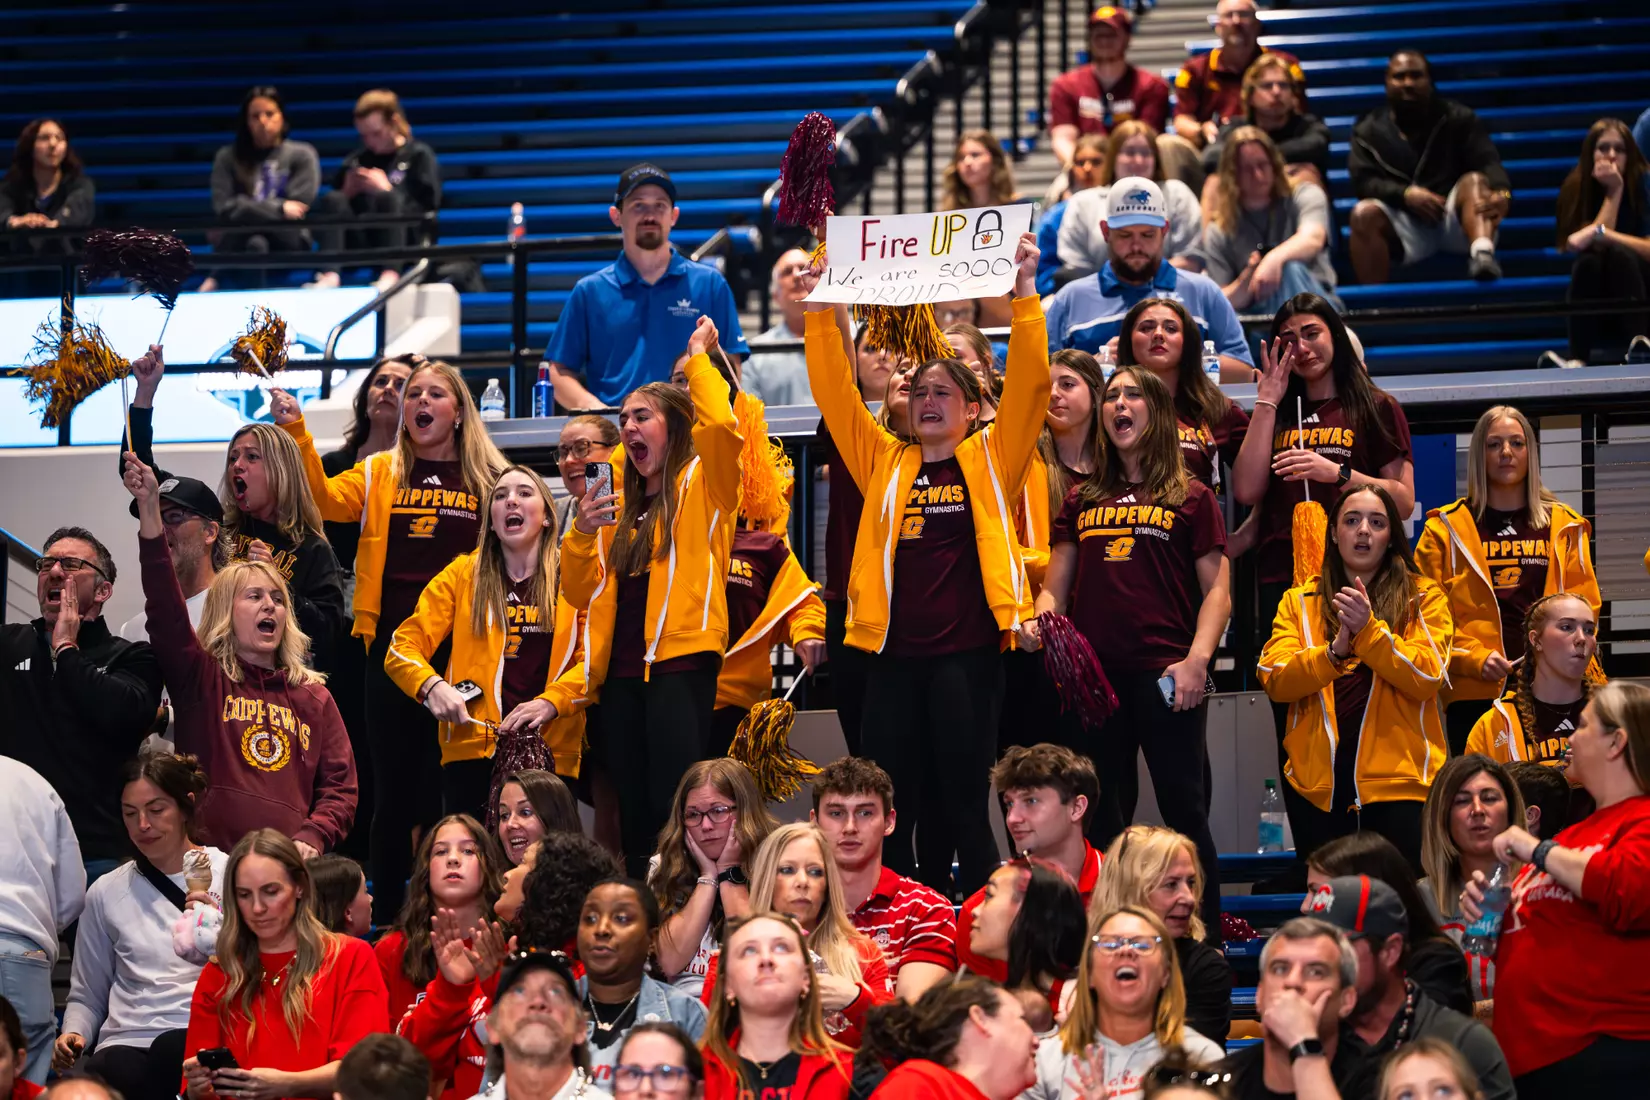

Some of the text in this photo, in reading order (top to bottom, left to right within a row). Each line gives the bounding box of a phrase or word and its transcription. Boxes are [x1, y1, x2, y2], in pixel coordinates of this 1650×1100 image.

[861, 213, 967, 261] Fire UP
[827, 267, 863, 286] We
[880, 269, 917, 282] are
[1315, 447, 1352, 458] GYMNASTICS
[439, 508, 477, 521] GYMNASTICS
[924, 503, 965, 514] GYMNASTICS
[1077, 505, 1175, 530] CHIPPEWAS
[1135, 526, 1170, 541] GYMNASTICS
